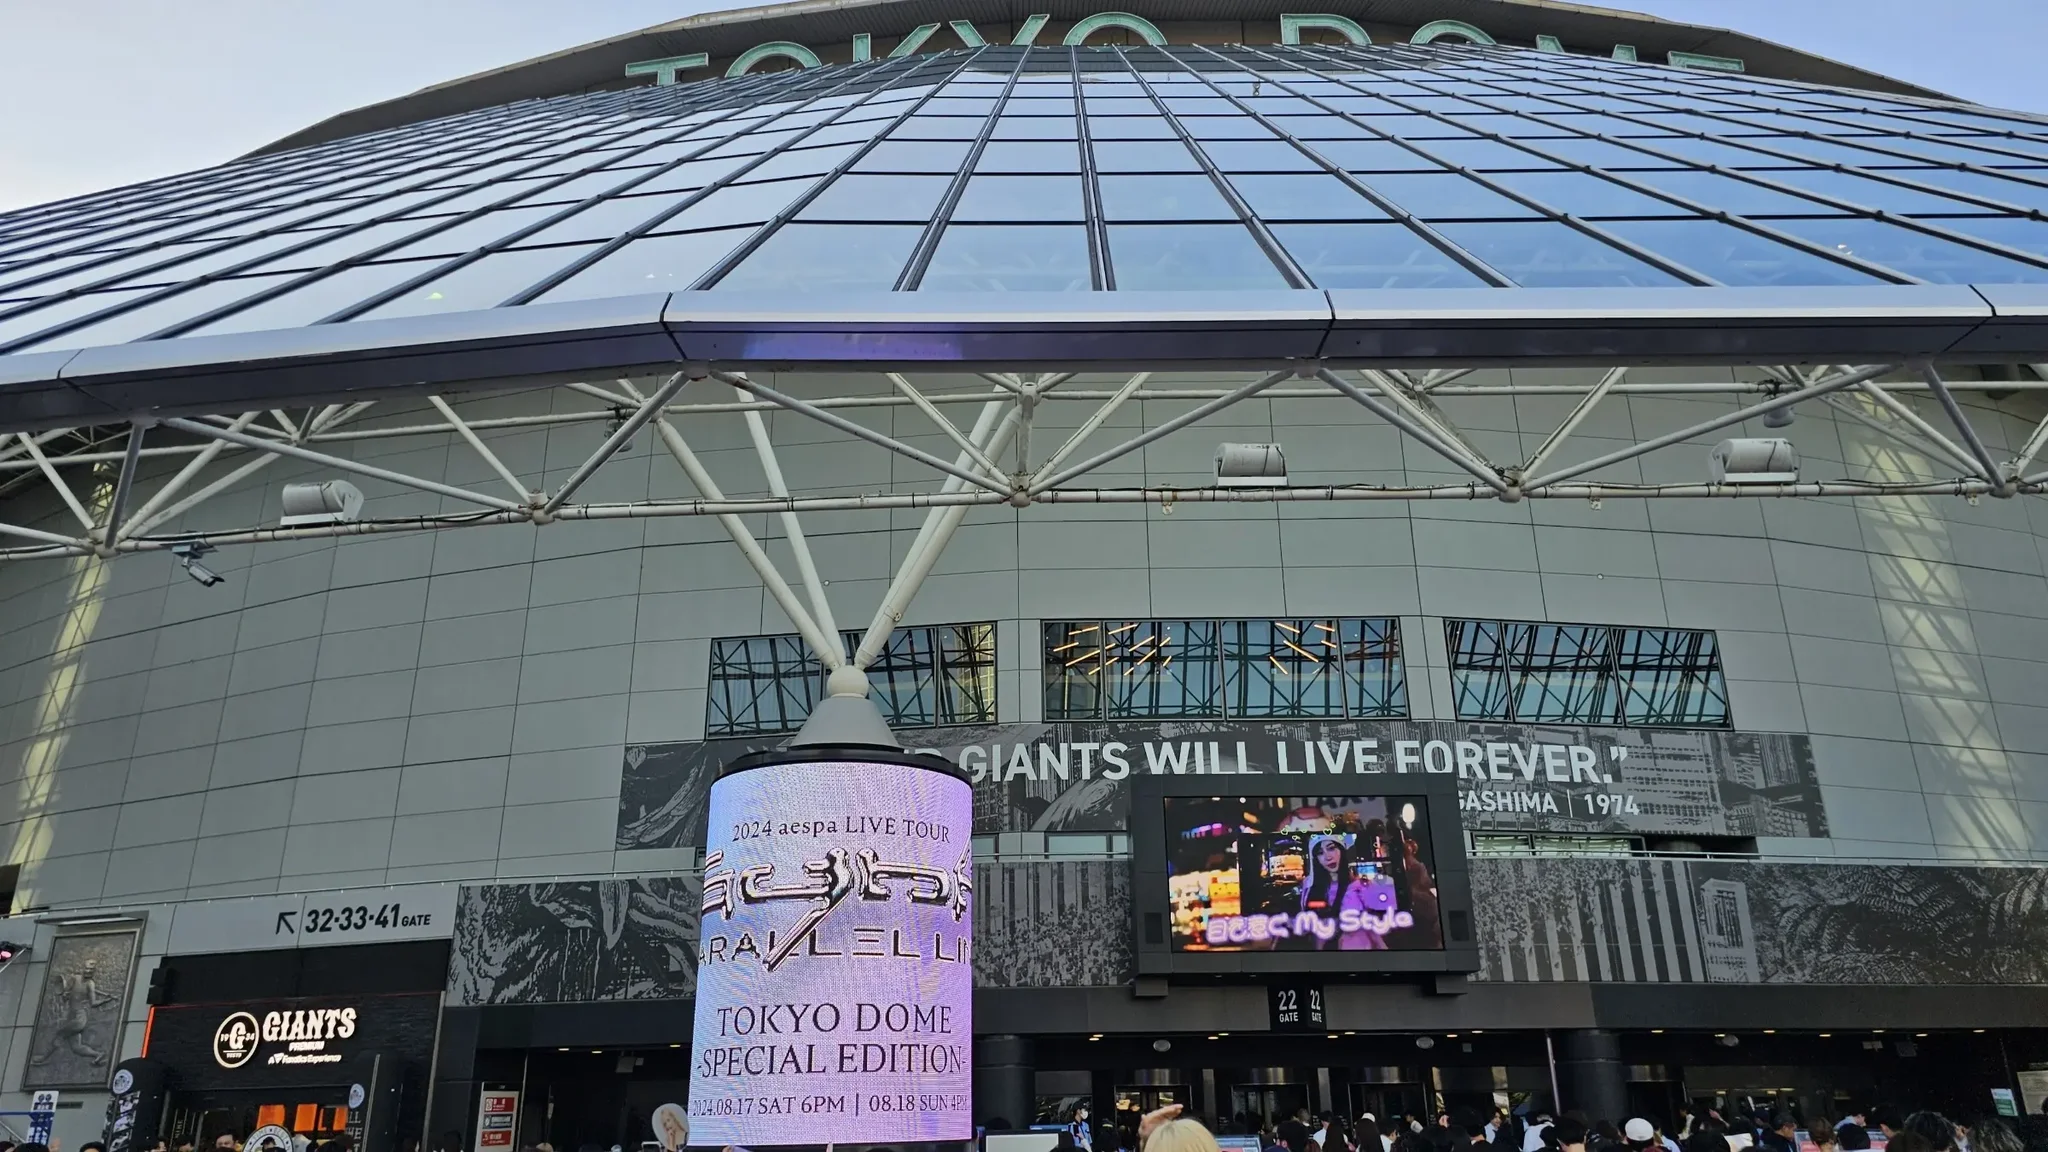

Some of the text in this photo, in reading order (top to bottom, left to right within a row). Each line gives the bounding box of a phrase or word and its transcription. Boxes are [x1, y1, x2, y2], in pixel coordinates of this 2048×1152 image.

[959, 741, 1130, 784] GIANTS
[1143, 741, 1263, 775] WILL
[1277, 740, 1382, 774] LIVE
[1584, 793, 1640, 815] 1974
[732, 816, 951, 843] 2024 aespa LIVE TOUR
[401, 914, 431, 927] GATE
[1294, 910, 1336, 940] My
[1339, 906, 1414, 936] Style
[1278, 989, 1297, 1010] 22
[1310, 989, 1321, 1010] 22
[262, 1007, 357, 1042] GIANTS
[717, 1003, 952, 1036] TOKYO DOME
[1279, 1012, 1299, 1023] GATE
[758, 1096, 796, 1115] SAT
[801, 1095, 845, 1114] 6PM
[869, 1094, 915, 1112] 08.18
[920, 1094, 948, 1111] SUN
